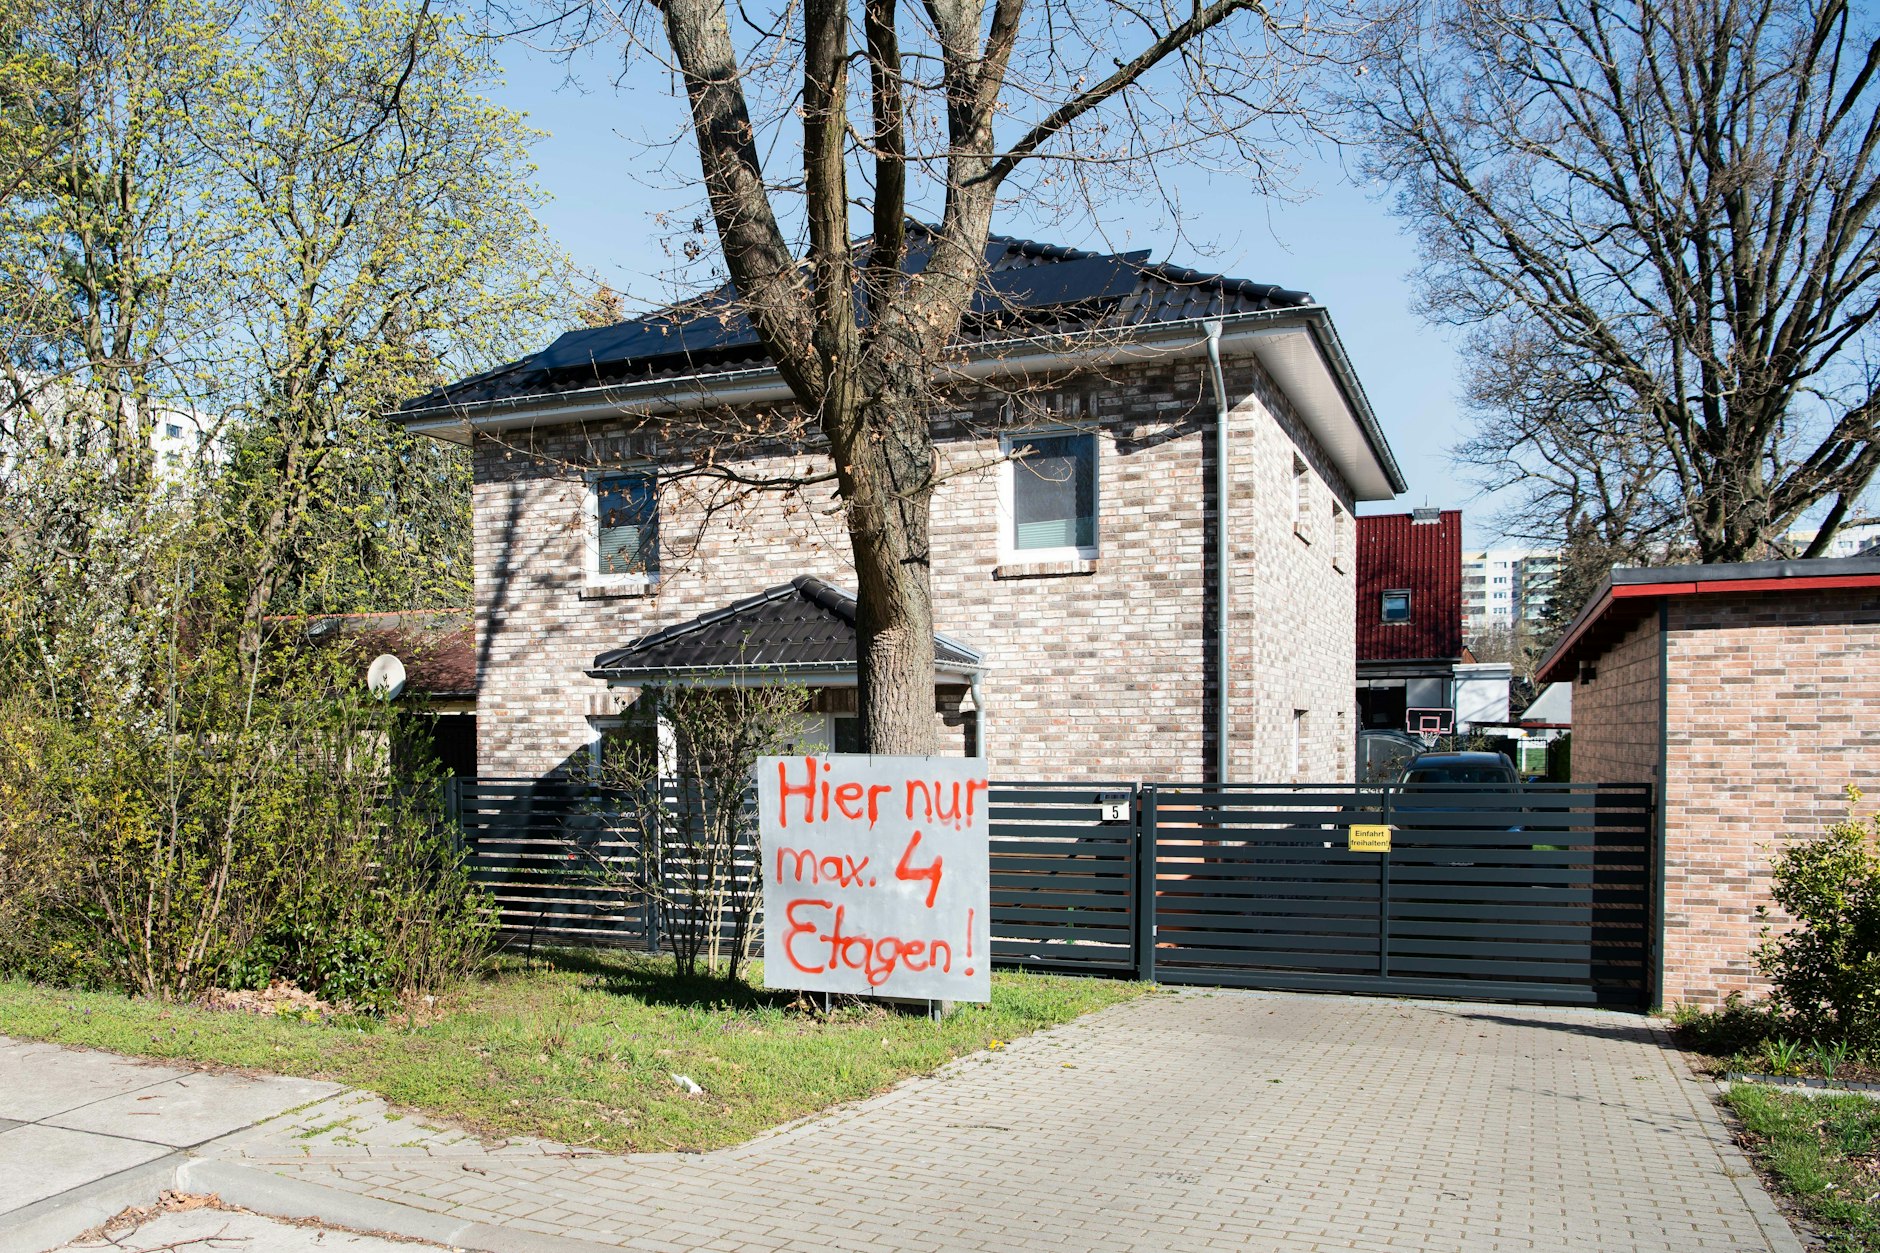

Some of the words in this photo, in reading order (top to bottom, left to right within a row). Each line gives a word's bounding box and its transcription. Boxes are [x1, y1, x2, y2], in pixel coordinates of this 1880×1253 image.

[778, 756, 892, 830] Hier
[906, 778, 989, 831] nur
[1112, 805, 1119, 819] 5
[776, 847, 877, 888] max.
[895, 830, 943, 908] 4
